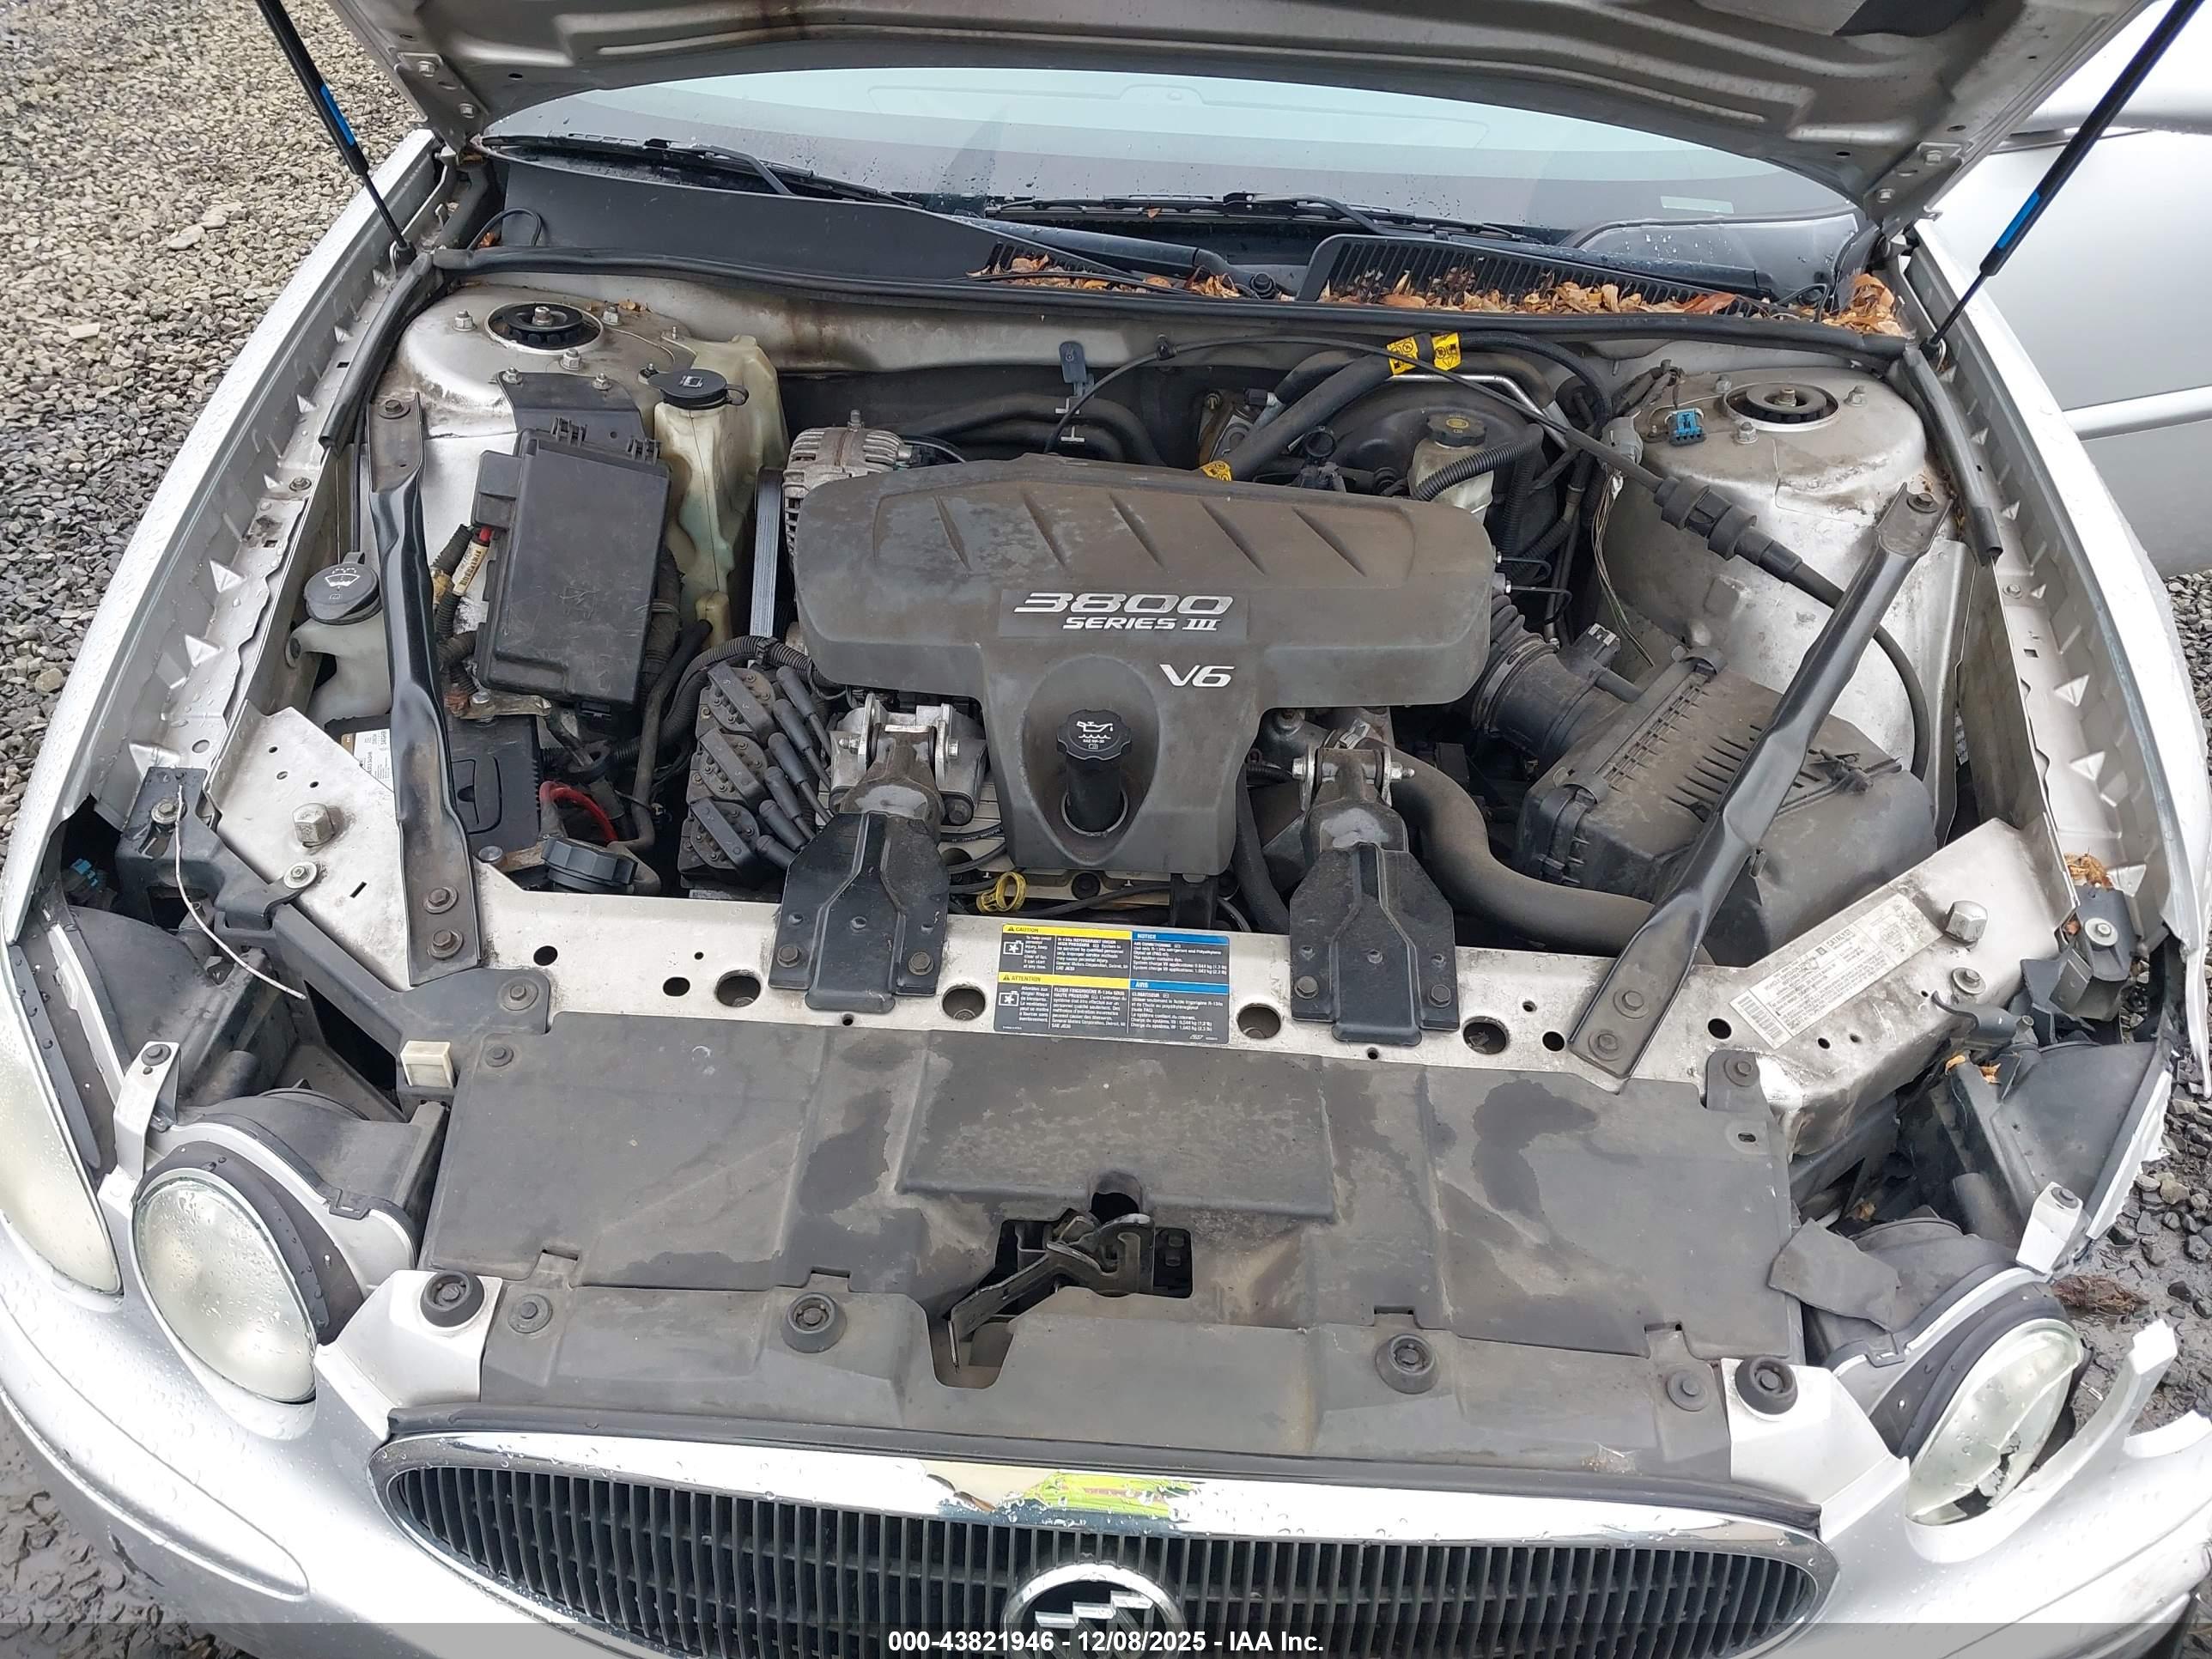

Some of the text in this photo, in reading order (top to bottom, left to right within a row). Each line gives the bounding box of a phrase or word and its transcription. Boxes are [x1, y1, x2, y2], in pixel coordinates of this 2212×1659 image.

[1014, 592, 1234, 615] 3800
[1062, 617, 1220, 631] SERIES III
[1159, 664, 1236, 688] V6
